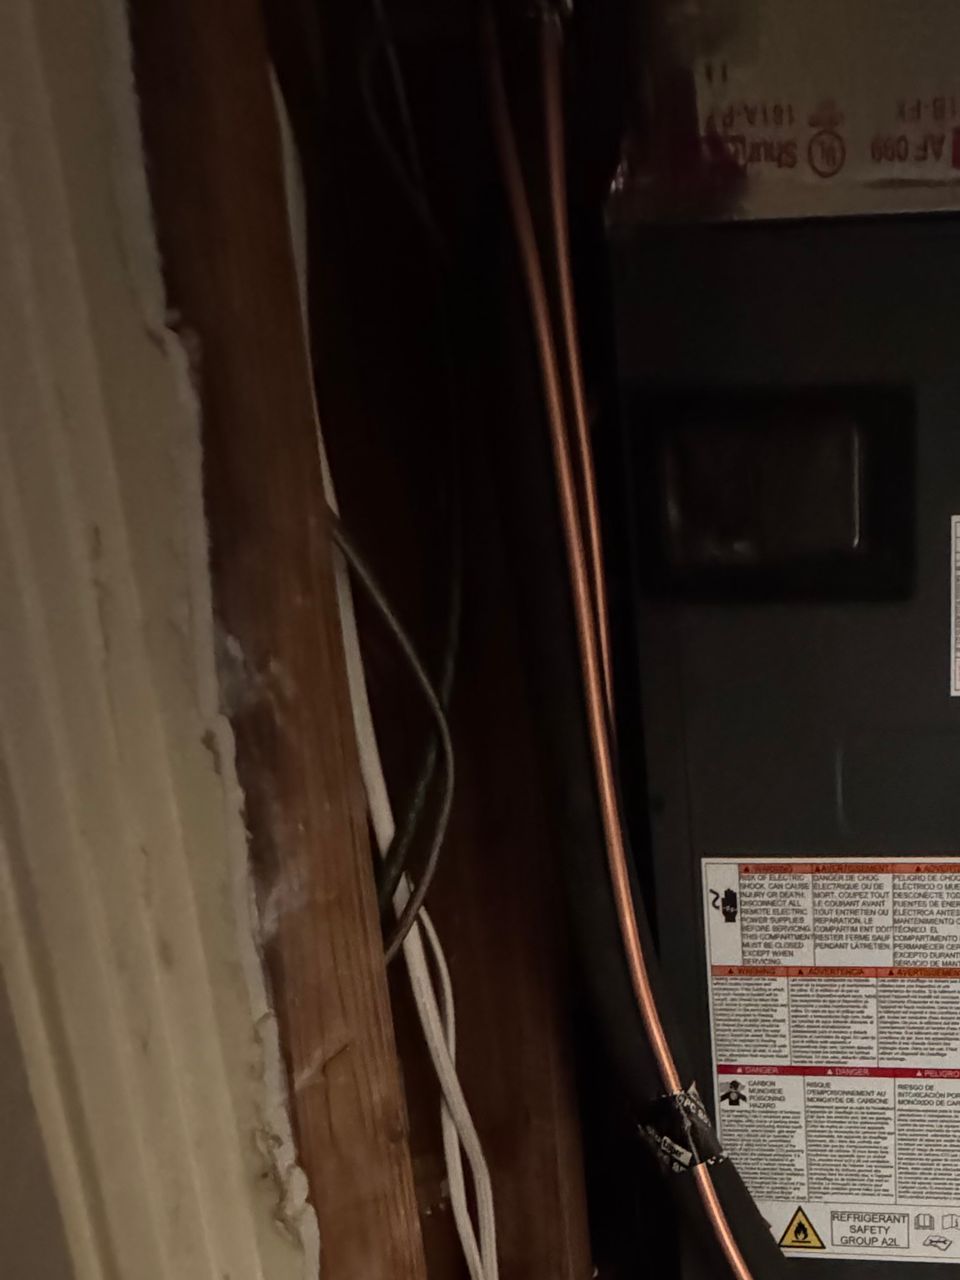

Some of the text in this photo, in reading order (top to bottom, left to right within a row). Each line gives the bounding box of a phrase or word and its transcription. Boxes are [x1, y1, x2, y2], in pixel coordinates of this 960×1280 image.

[832, 1213, 906, 1223] REFRIGERANT
[849, 1225, 890, 1234] SAFETY
[840, 1236, 900, 1246] GROUP A2L
